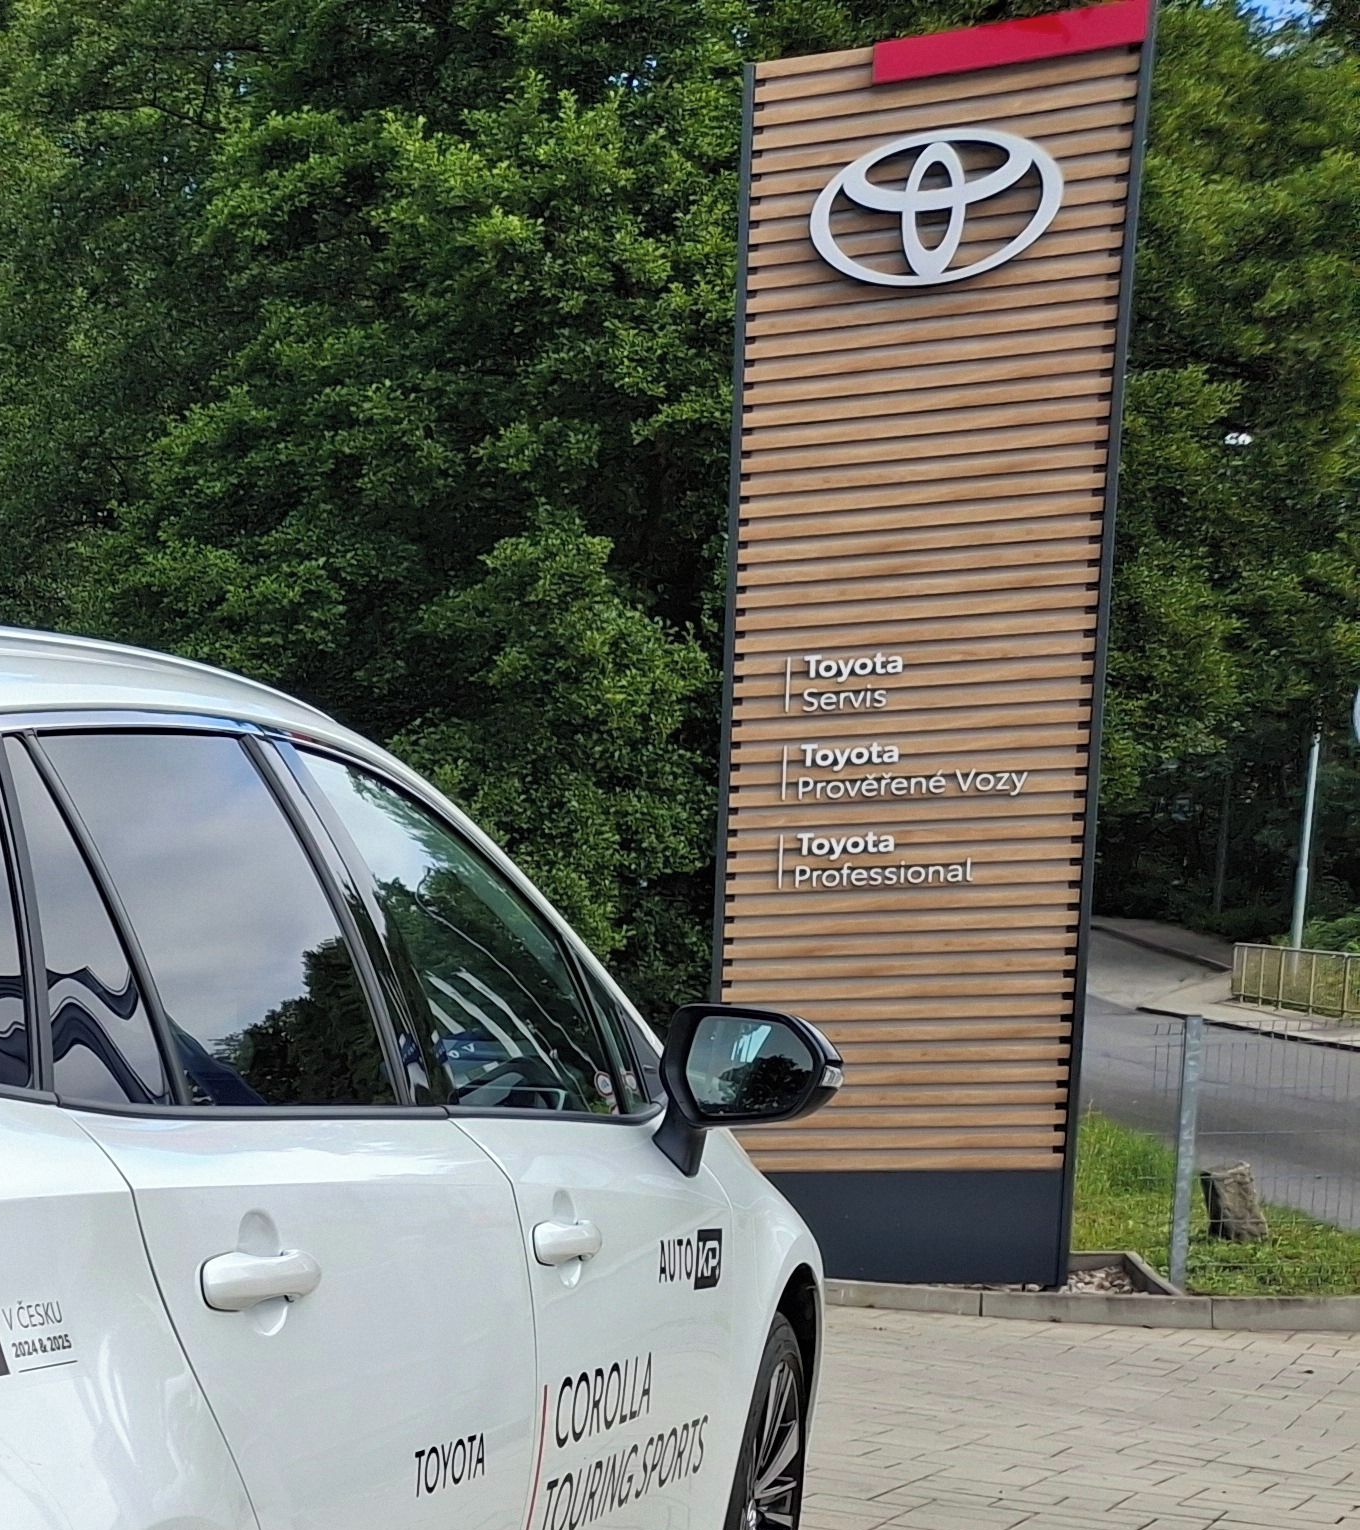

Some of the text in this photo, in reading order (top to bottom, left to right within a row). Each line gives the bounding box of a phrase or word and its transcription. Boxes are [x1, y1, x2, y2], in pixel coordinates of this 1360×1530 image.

[804, 653, 904, 683] Toyota
[802, 685, 888, 713] Servis
[800, 742, 900, 772] Toyota
[797, 768, 1029, 801] Prověřené Vozy
[796, 832, 896, 861] Toyota
[794, 857, 974, 889] Professional
[659, 1237, 693, 1284] AUTO
[2, 1301, 64, 1331] V ČESKU
[11, 1334, 73, 1359] 2024 & 2025
[555, 1352, 653, 1449] COROLLA
[415, 1432, 486, 1498] TOYOTA
[634, 1415, 709, 1500] SPORTS
